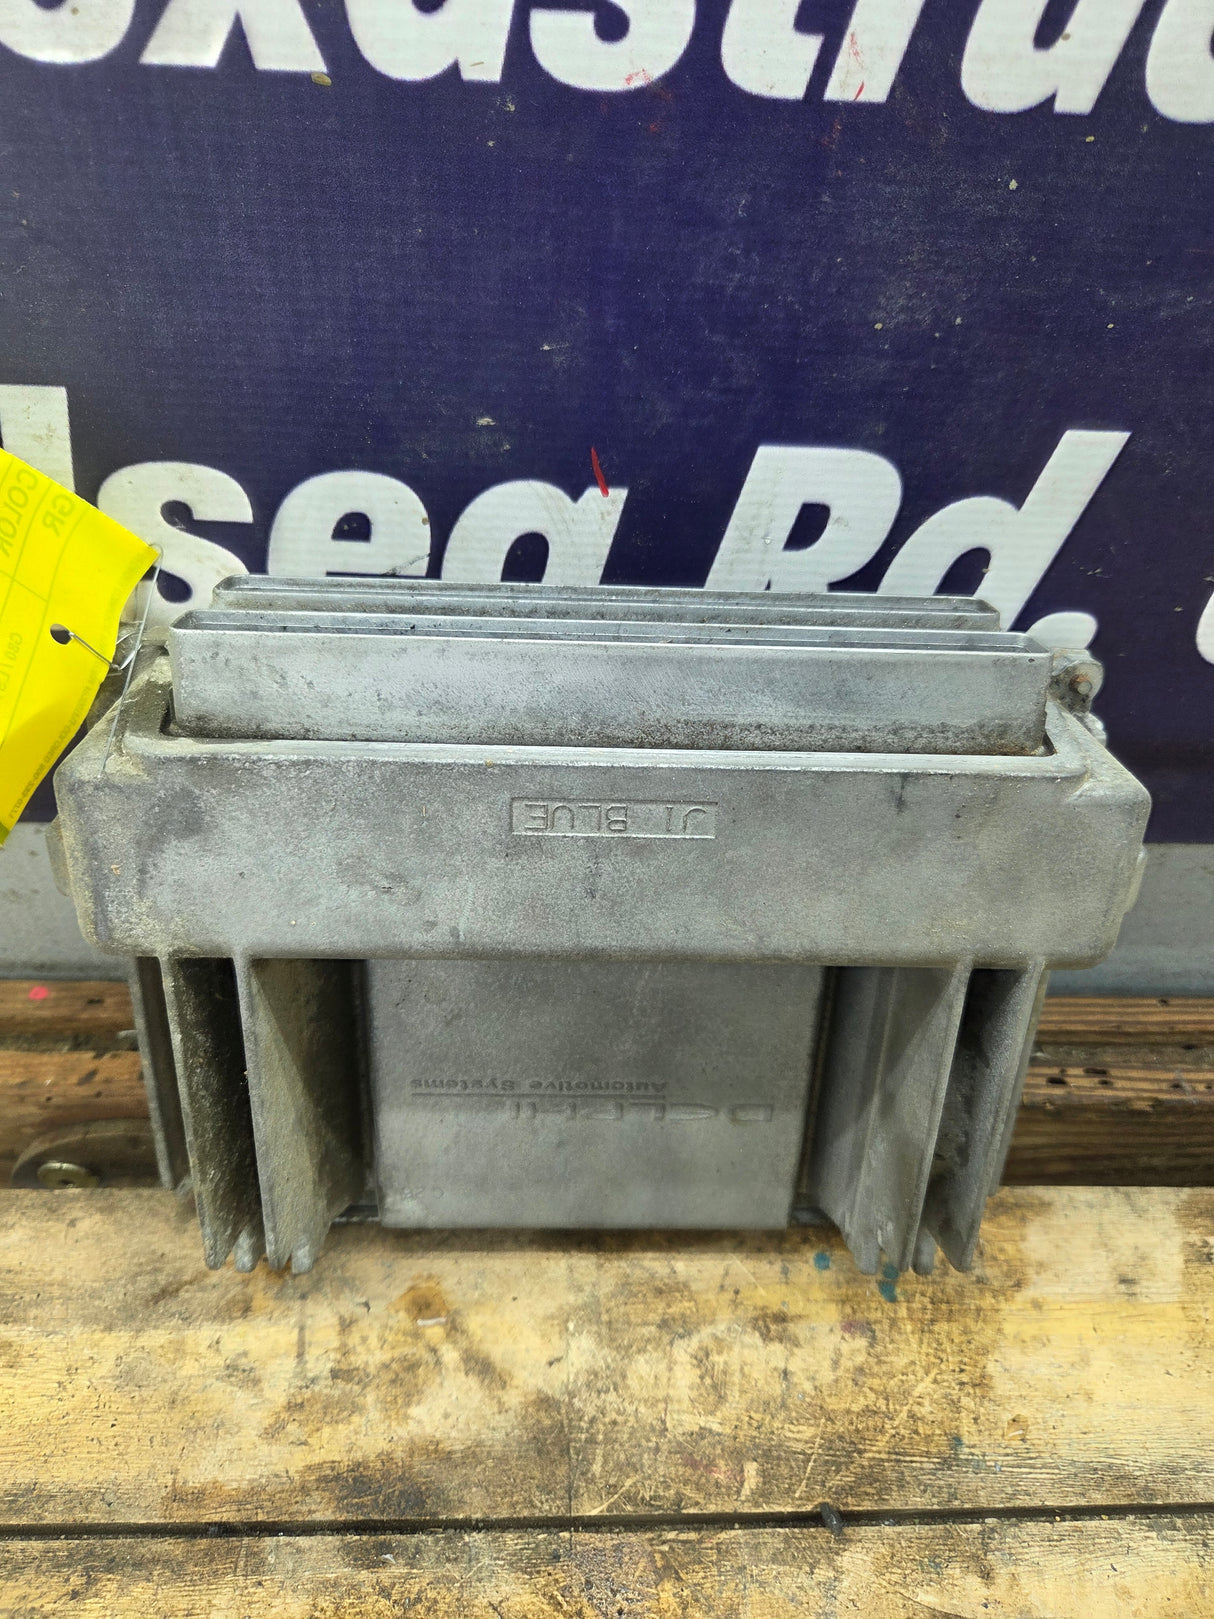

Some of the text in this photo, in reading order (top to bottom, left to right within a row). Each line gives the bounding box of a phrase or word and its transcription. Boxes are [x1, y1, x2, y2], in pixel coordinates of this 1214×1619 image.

[523, 802, 629, 833] BLUE
[410, 1078, 669, 1094] Automotive Systems
